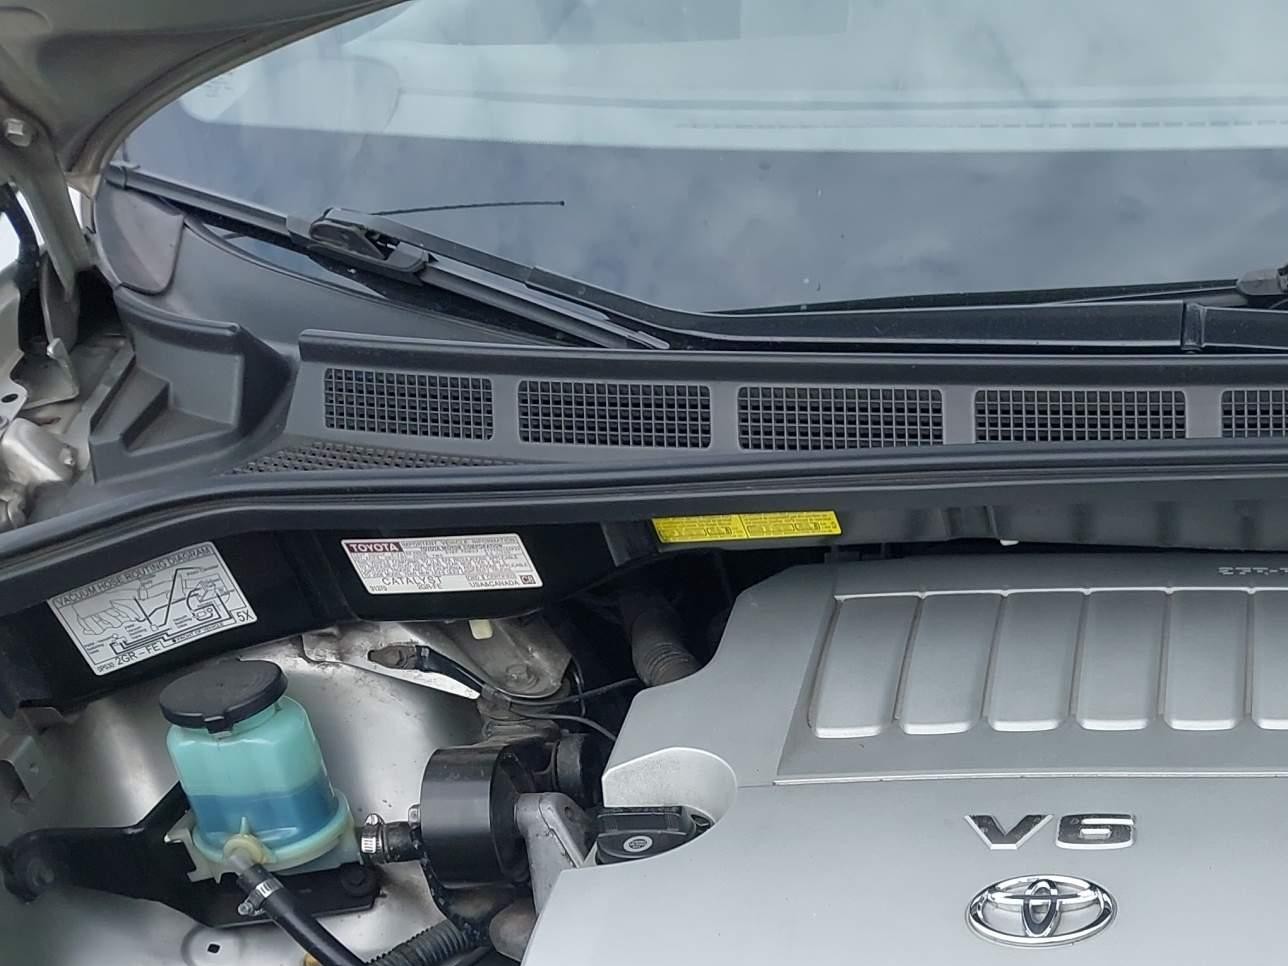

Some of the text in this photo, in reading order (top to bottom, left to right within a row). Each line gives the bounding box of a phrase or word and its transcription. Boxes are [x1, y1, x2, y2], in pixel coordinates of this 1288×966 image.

[350, 543, 399, 552] TOYOTA
[53, 585, 97, 607] VACUUM
[99, 575, 124, 592] HOSE
[126, 561, 168, 581] ROUTING
[169, 546, 211, 565] DIAGRAM
[381, 576, 443, 586] CATALYST
[237, 610, 254, 623] 5X
[964, 814, 1135, 850] V6
